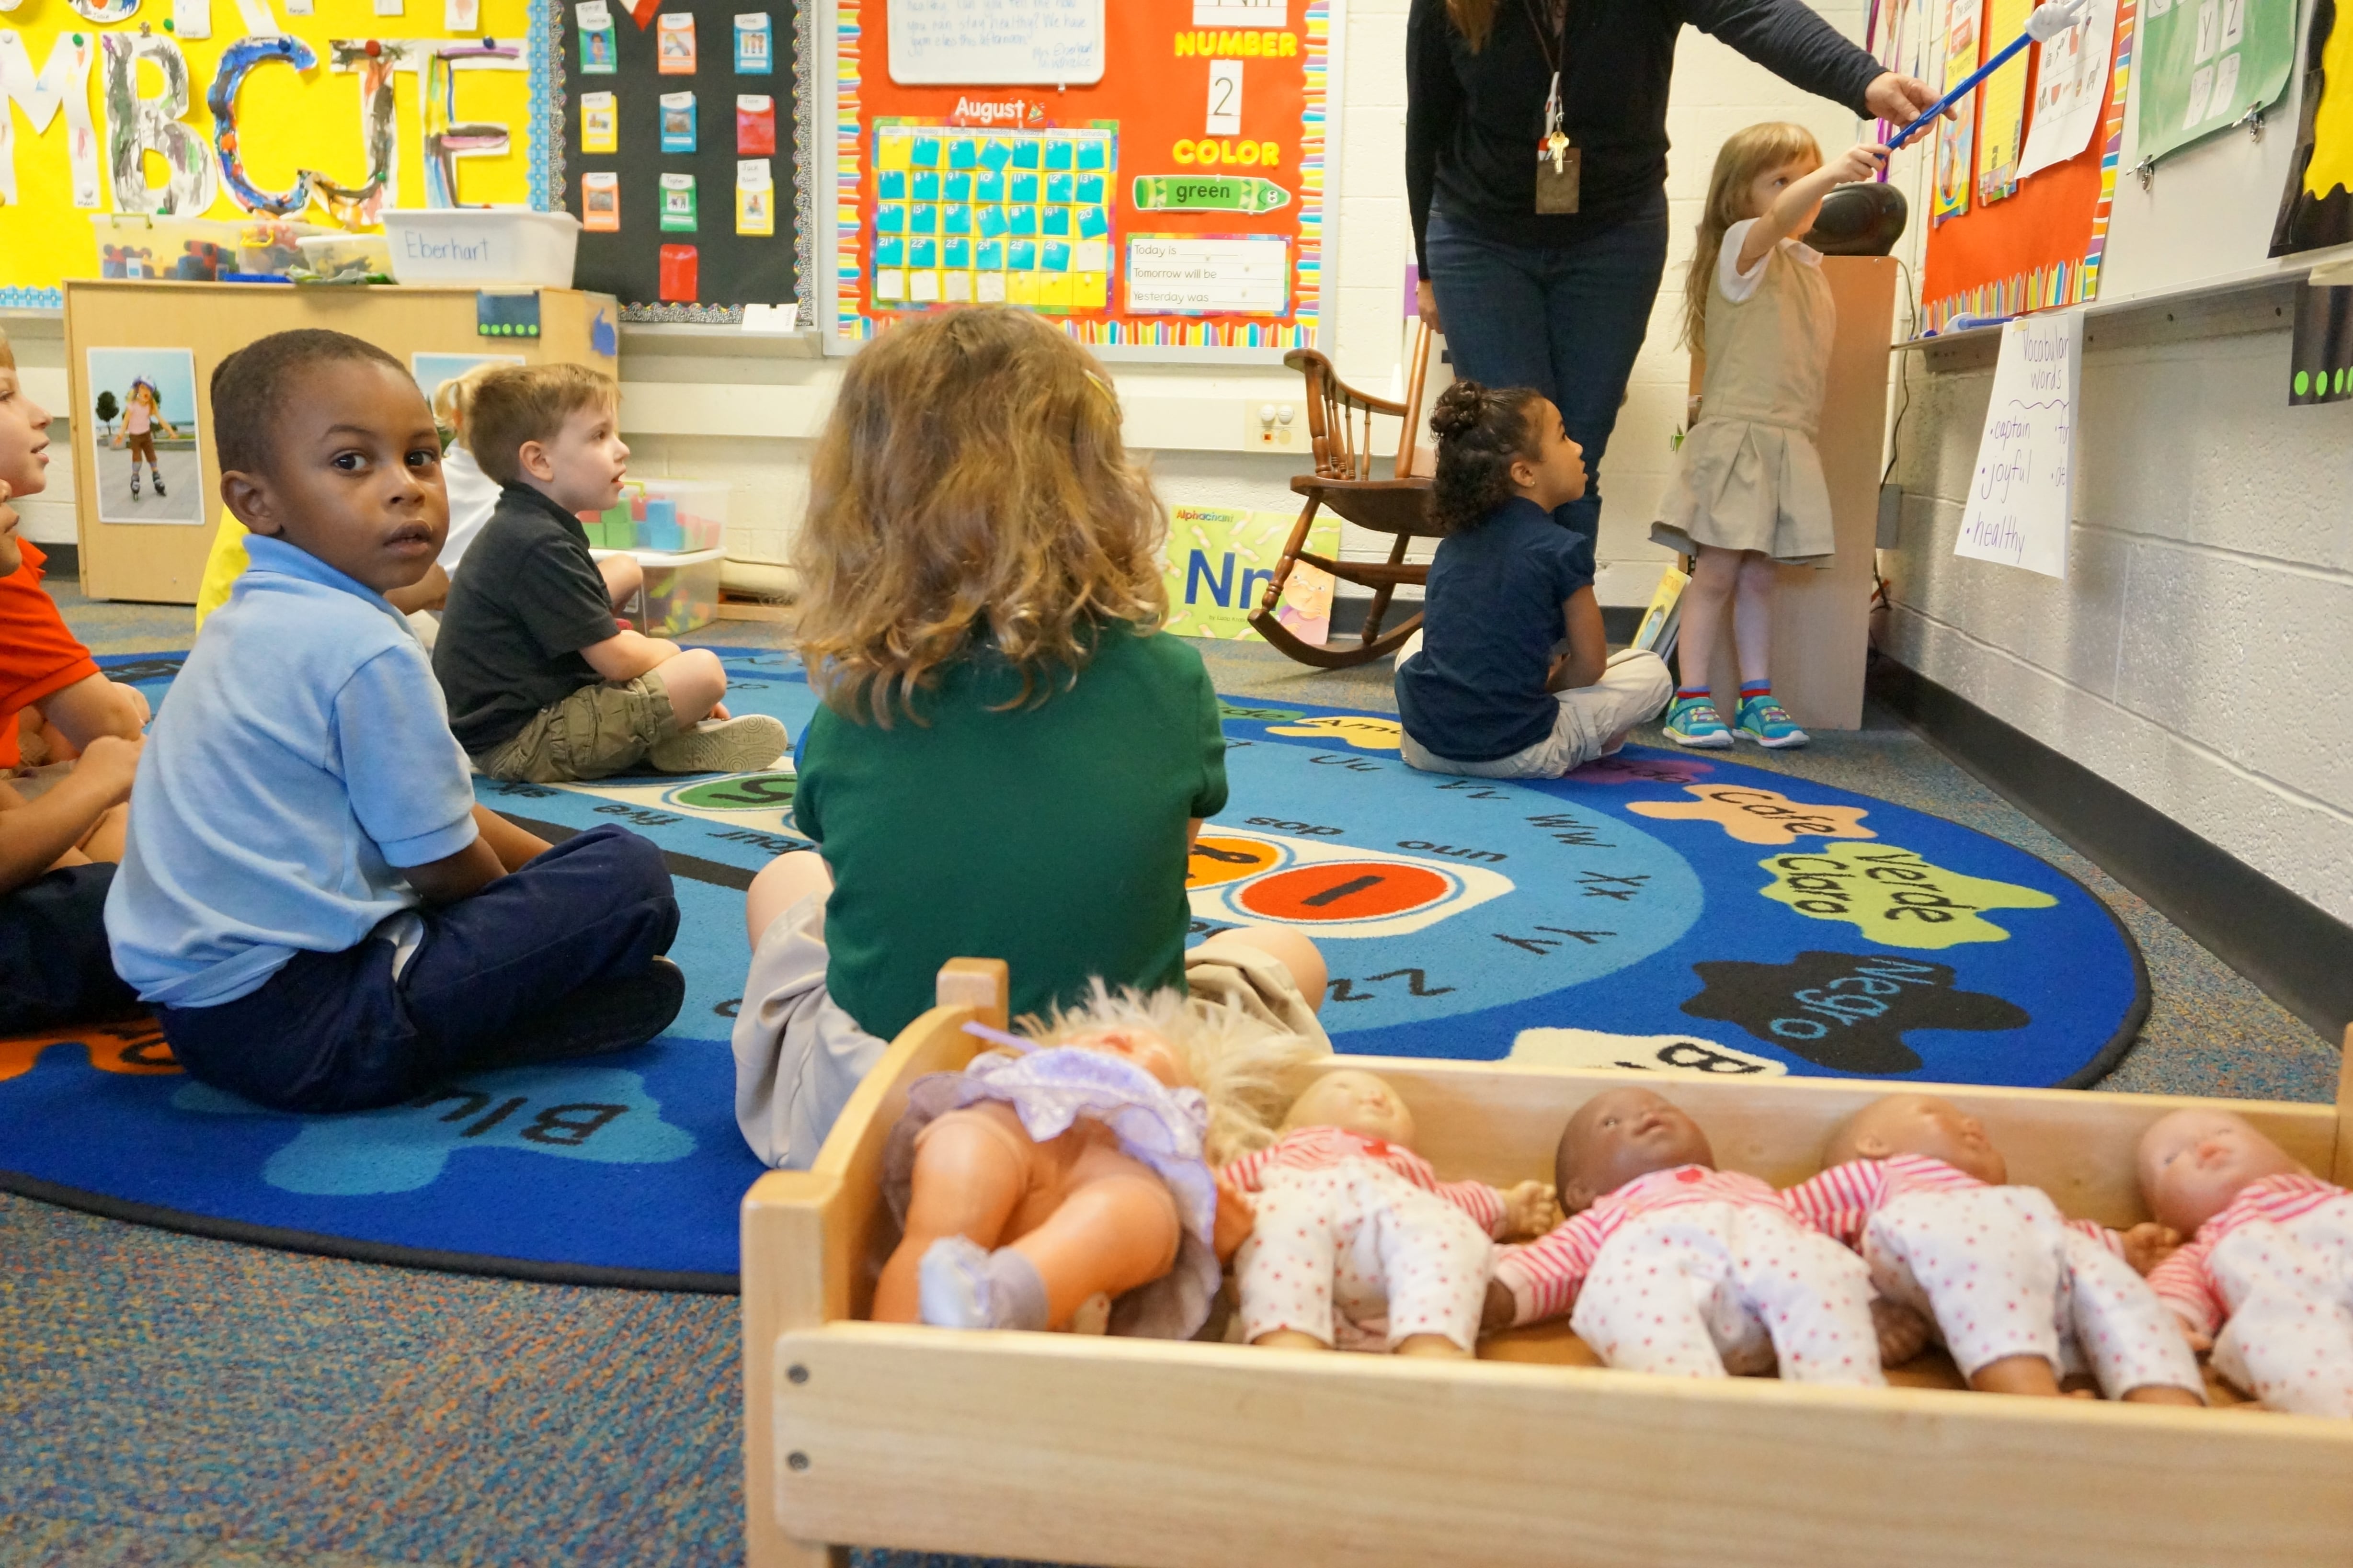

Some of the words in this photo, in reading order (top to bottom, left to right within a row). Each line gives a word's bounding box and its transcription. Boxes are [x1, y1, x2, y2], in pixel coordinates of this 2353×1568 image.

[1175, 31, 1297, 57] NUMBER
[1213, 77, 1233, 116] 2
[954, 97, 1026, 123] August
[950, 141, 958, 150] 2
[1015, 139, 1021, 148] 4
[1048, 140, 1054, 149] 5
[1079, 142, 1085, 150] 6
[1172, 139, 1280, 166] COLOR
[880, 171, 886, 181] 7
[915, 172, 922, 181] 8
[948, 172, 954, 181] 9
[980, 173, 991, 182] 10
[1013, 174, 1021, 182] 11
[1049, 175, 1059, 183] 12
[1079, 174, 1089, 183] 13
[1176, 184, 1231, 204] green
[880, 204, 889, 213] 14
[913, 205, 921, 214] 15
[946, 205, 955, 215] 16
[979, 210, 987, 220] 17
[1011, 207, 1019, 216] 18
[1045, 207, 1053, 216] 19
[1079, 209, 1093, 220] 20
[405, 230, 489, 262] Eberhart
[879, 238, 889, 246] 21
[911, 239, 924, 248] 22
[946, 239, 957, 248] 23
[978, 241, 990, 250] 24
[1010, 241, 1022, 250] 25
[1045, 241, 1058, 250] 26
[1134, 244, 1166, 258] Today
[1167, 244, 1177, 255] is
[1133, 268, 1182, 280] Tomorrow
[1185, 267, 1201, 279] will
[1203, 269, 1217, 279] be
[1133, 291, 1185, 304] Yesterday
[1188, 293, 1209, 302] was
[2022, 322, 2069, 363] Vocabular
[2030, 367, 2062, 391] words
[1994, 415, 2031, 451] captain
[1980, 449, 2032, 504] joyful
[2055, 463, 2066, 488] de
[1972, 511, 2026, 564] healthy
[1309, 754, 1384, 772] Uu
[707, 776, 797, 804] 5
[1434, 779, 1510, 801] Vv
[592, 805, 684, 827] five
[1245, 816, 1344, 836] dos
[1708, 789, 1838, 839] Cafe
[706, 829, 816, 855] four
[1525, 812, 1617, 848] Ww
[1396, 840, 1508, 863] uno
[1574, 870, 1651, 901] Xx
[1776, 856, 1857, 916] Claro
[1853, 852, 1981, 925] Verde
[1492, 925, 1617, 956] Yy
[1326, 966, 1457, 1003] Zz
[1768, 956, 1937, 1041] Negro
[411, 1089, 629, 1147] Blu
